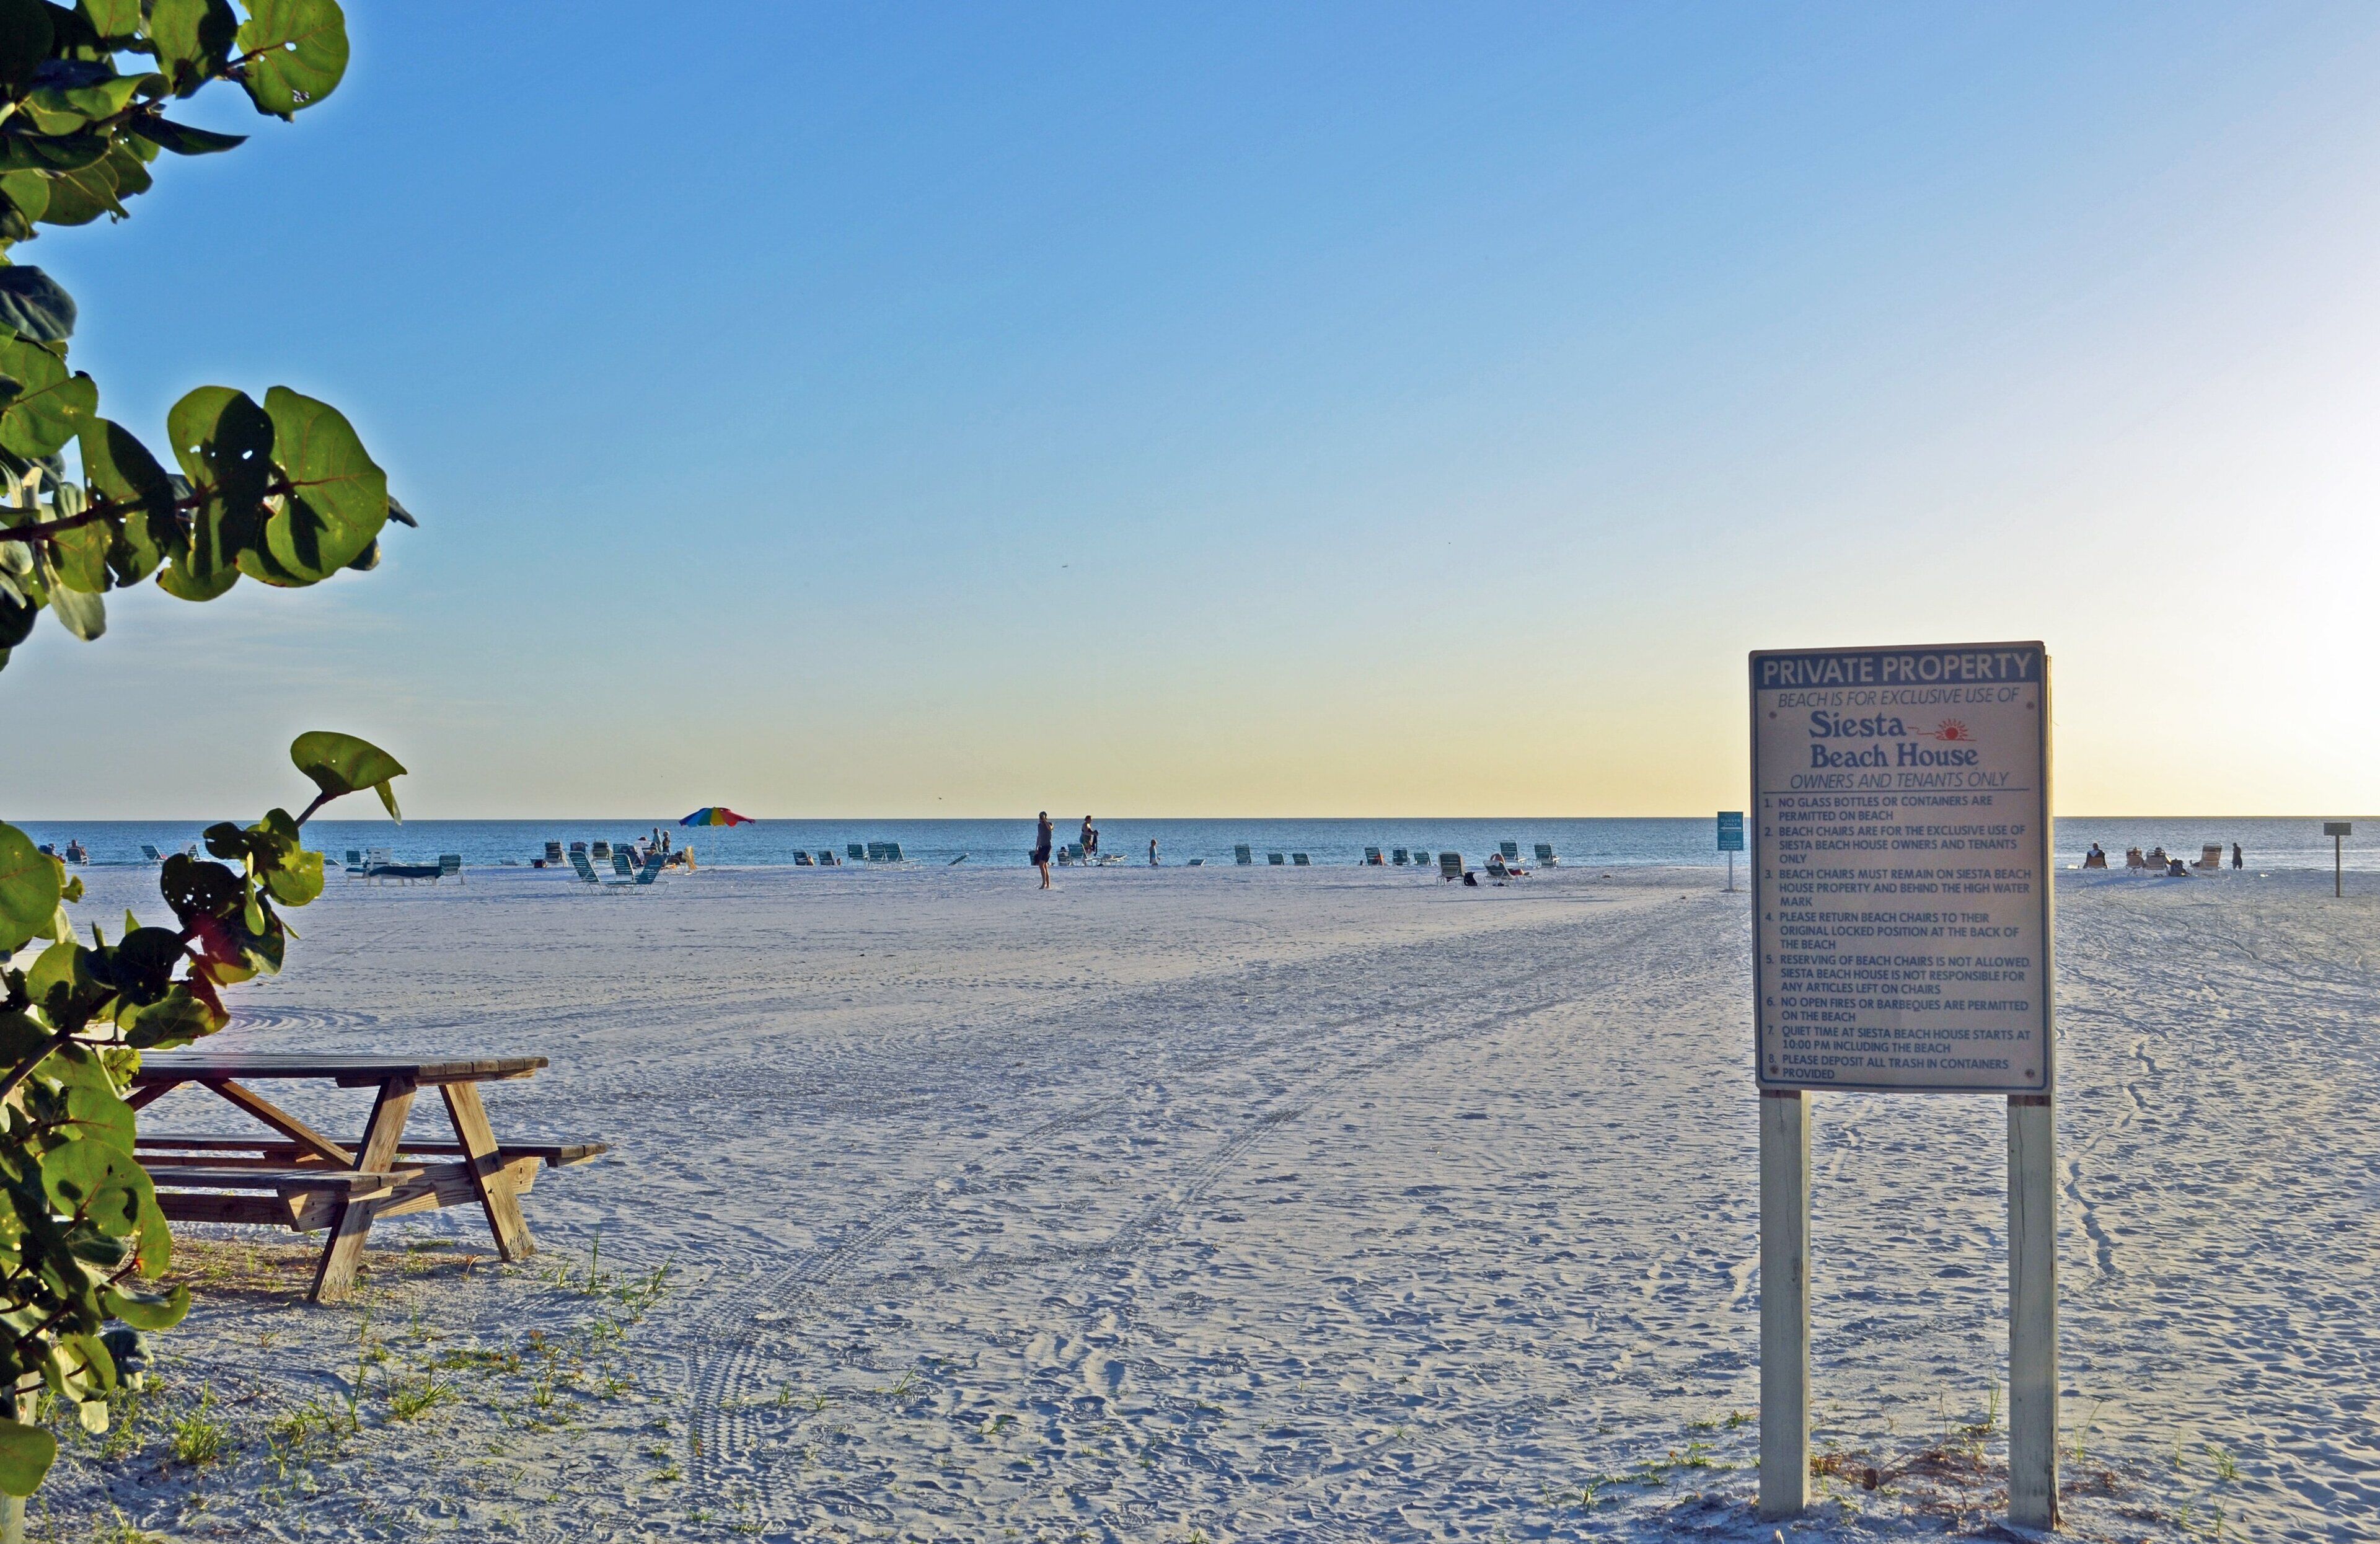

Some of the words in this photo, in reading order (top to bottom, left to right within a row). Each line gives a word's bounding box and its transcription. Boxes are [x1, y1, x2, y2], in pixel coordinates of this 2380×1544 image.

[1763, 657, 1874, 685] PRIVATE
[1882, 653, 2033, 681] PROPERTY
[1778, 692, 1828, 708] BEACH
[1831, 692, 1842, 706] IS
[1846, 691, 1875, 706] FOR
[1881, 689, 1962, 705] EXCLUSIVE
[1965, 687, 1994, 703] USE
[1998, 687, 2020, 702] OF
[1809, 711, 1907, 738] Siesta
[1810, 744, 1889, 769] Beach
[1897, 743, 1978, 767] House
[1791, 773, 1853, 789] OWNERS
[1859, 772, 1892, 788] AND
[1897, 772, 1963, 788] TENANTS
[1968, 771, 2009, 787] ONLY
[1764, 798, 1773, 808] 1.
[1779, 798, 1795, 808] NO
[1797, 798, 1831, 808] GLASS
[1835, 797, 1879, 807] BOTTLES
[1882, 796, 1898, 806] OR
[1901, 796, 1968, 806] CONTAINERS
[1971, 795, 1993, 805] ARE
[1779, 811, 1836, 821] PERMITTED
[1839, 811, 1855, 821] ON
[1859, 811, 1893, 821] BEACH
[1764, 826, 1773, 837] 2.
[1779, 827, 1813, 836] BEACH
[1816, 826, 1854, 836] CHAIRS
[1857, 826, 1878, 836] ARE
[1880, 826, 1902, 836] FOR
[1905, 826, 1924, 836] THE
[1927, 826, 1985, 836] EXCLUSIVE
[1988, 825, 2007, 835] USE
[2011, 825, 2025, 835] OF
[1779, 840, 1812, 850] SIESTA
[1815, 840, 1850, 850] BEACH
[1853, 840, 1888, 850] HOUSE
[1891, 840, 1937, 850] OWNERS
[1941, 839, 1965, 849] AND
[1968, 839, 2017, 849] TENANTS
[1779, 854, 1807, 864] ONLY
[1765, 870, 1773, 879] 3.
[1779, 870, 1814, 879] BEACH
[1817, 869, 1854, 879] CHAIRS
[1858, 869, 1888, 879] MUST
[1891, 869, 1934, 879] REMAIN
[1936, 869, 1953, 879] ON
[1956, 869, 1991, 879] SIESTA
[1994, 869, 2031, 879] BEACH
[1779, 883, 1814, 893] HOUSE
[1817, 883, 1870, 893] PROPERTY
[1873, 883, 1897, 893] AND
[1900, 883, 1938, 893] BEHIND
[1942, 883, 1960, 893] THE
[1963, 883, 1990, 893] HIGH
[1993, 883, 2030, 893] WATER
[1780, 897, 1812, 906] MARK
[1765, 912, 1774, 922] 4.
[1779, 912, 1816, 922] PLEASE
[1819, 912, 1858, 922] RETURN
[1861, 912, 1897, 922] BEACH
[1899, 913, 1939, 922] CHAIRS
[1942, 913, 1957, 923] TO
[1960, 913, 1990, 923] THEIR
[1780, 926, 1828, 935] ORIGINAL
[1831, 926, 1874, 936] LOCKED
[1877, 927, 1928, 937] POSITION
[1931, 927, 1944, 937] AT
[1948, 927, 1967, 937] THE
[1970, 927, 2000, 937] BACK
[2003, 927, 2019, 937] OF
[1781, 940, 1799, 949] THE
[1802, 940, 1836, 950] BEACH
[1766, 955, 1774, 964] 5.
[1781, 955, 1836, 965] RESERVING
[1839, 955, 1853, 965] OF
[1856, 956, 1892, 966] BEACH
[1894, 956, 1933, 966] CHAIRS
[1936, 956, 1946, 967] IS
[1948, 957, 1972, 967] NOT
[1975, 957, 2031, 968] ALLOWED.
[1781, 969, 1814, 978] SIESTA
[1817, 969, 1851, 979] BEACH
[1854, 970, 1889, 979] HOUSE
[1892, 970, 1901, 980] IS
[1903, 971, 1927, 981] NOT
[1929, 971, 2001, 981] RESPONSIBLE
[2003, 971, 2025, 981] FOR
[1781, 982, 1803, 992] ANY
[1806, 983, 1853, 993] ARTICLES
[1856, 984, 1879, 994] LEFT
[1881, 984, 1898, 994] ON
[1901, 984, 1941, 994] CHAIRS
[1766, 997, 1775, 1007] 6.
[1781, 997, 1797, 1007] NO
[1800, 997, 1827, 1007] OPEN
[1830, 998, 1856, 1008] FIRES
[1859, 999, 1874, 1008] OR
[1877, 999, 1941, 1012] BARBEQUES
[1944, 1000, 1965, 1010] ARE
[1968, 1000, 2029, 1011] PERMITTED
[1782, 1011, 1798, 1021] ON
[1800, 1011, 1818, 1021] THE
[1822, 1012, 1856, 1022] BEACH
[1767, 1025, 1774, 1035] 7.
[1782, 1026, 1812, 1037] QUIET
[1814, 1026, 1838, 1036] TIME
[1841, 1028, 1855, 1037] AT
[1858, 1028, 1891, 1038] SIESTA
[1894, 1029, 1930, 1039] BEACH
[1934, 1030, 1970, 1039] HOUSE
[1973, 1030, 2014, 1040] STARTS
[2016, 1030, 2031, 1041] AT
[1783, 1039, 1811, 1049] 10:00
[1814, 1041, 1831, 1050] PM
[1833, 1041, 1889, 1052] INCLUDING
[1892, 1043, 1911, 1052] THE
[1914, 1043, 1950, 1053] BEACH
[1768, 1054, 1776, 1064] 8.
[1783, 1054, 1818, 1065] PLEASE
[1822, 1056, 1864, 1066] DEPOSIT
[1867, 1057, 1886, 1067] ALL
[1889, 1058, 1924, 1068] TRASH
[1927, 1059, 1937, 1069] IN
[1940, 1059, 2009, 1070] CONTAINERS
[1783, 1068, 1835, 1079] PROVIDED
